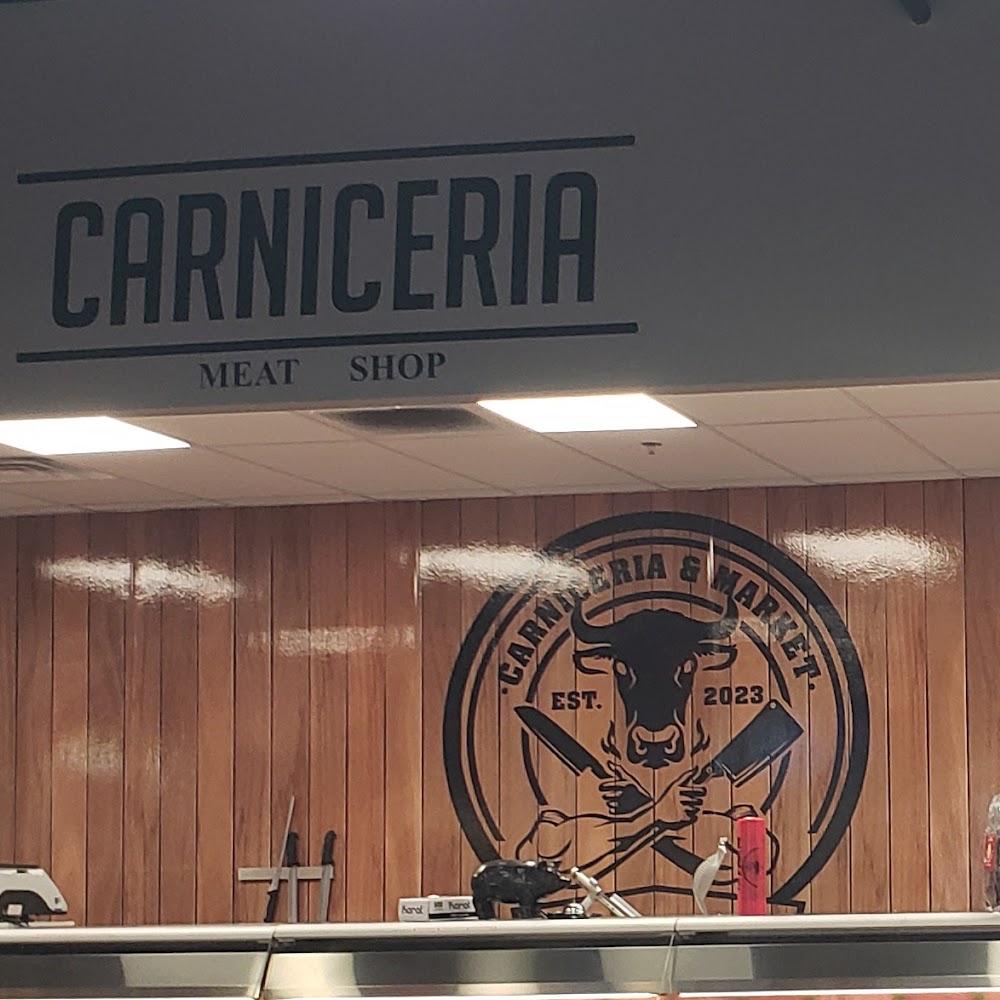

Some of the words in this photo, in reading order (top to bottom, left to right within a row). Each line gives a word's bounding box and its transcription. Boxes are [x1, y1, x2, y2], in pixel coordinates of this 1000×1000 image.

[51, 170, 598, 328] CARNICERIA
[200, 358, 300, 389] MEAT
[349, 350, 446, 383] SHOP
[680, 556, 701, 583] &
[711, 565, 821, 679] MARKET
[551, 690, 603, 711] EST.
[704, 685, 764, 706] 2023
